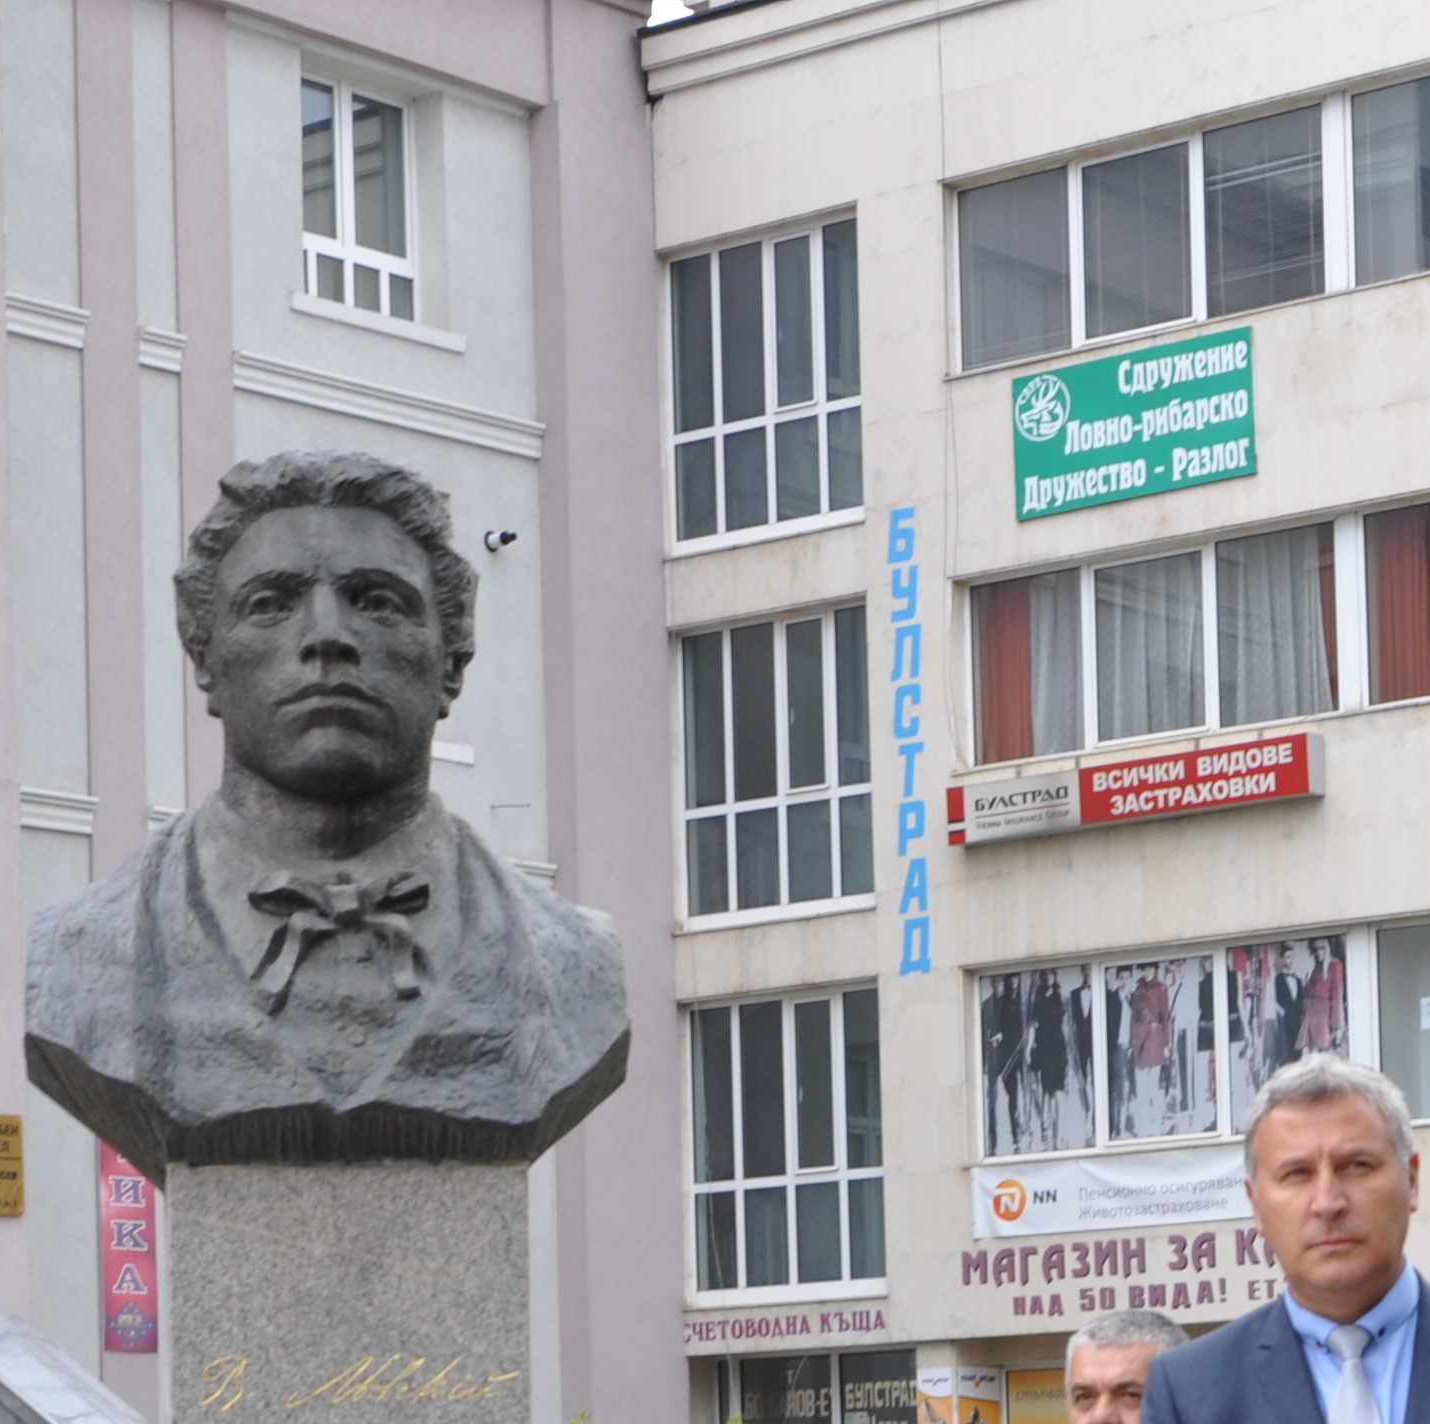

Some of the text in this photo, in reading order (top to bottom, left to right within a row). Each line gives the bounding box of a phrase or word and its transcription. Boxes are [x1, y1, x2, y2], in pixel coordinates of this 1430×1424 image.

[1117, 340, 1248, 396] Сдружение
[1064, 388, 1249, 455] Ловно-рибарско
[1022, 458, 1147, 515] Дружество
[1172, 438, 1250, 482] Разлог
[887, 506, 932, 977] БУЛСТРАД
[1092, 742, 1293, 793] ВСИЧКИ ВИДОВЕ
[974, 783, 1069, 813] БУЛСТРАД
[1110, 771, 1276, 816] ЗАСТРАХОВКИ
[1032, 1188, 1057, 1205] NN
[1078, 1175, 1245, 1202] Пенсионно осигуряван
[1078, 1196, 1229, 1221] Животозастраховане
[108, 1153, 148, 1295] ИКА
[961, 1236, 1147, 1288] МАГАЗИН
[1168, 1231, 1216, 1274] ЗА
[1013, 1293, 1064, 1318] НАД
[1079, 1286, 1116, 1313] 50
[1128, 1276, 1227, 1311] ВИДА!
[820, 1309, 886, 1334] КЪЩА
